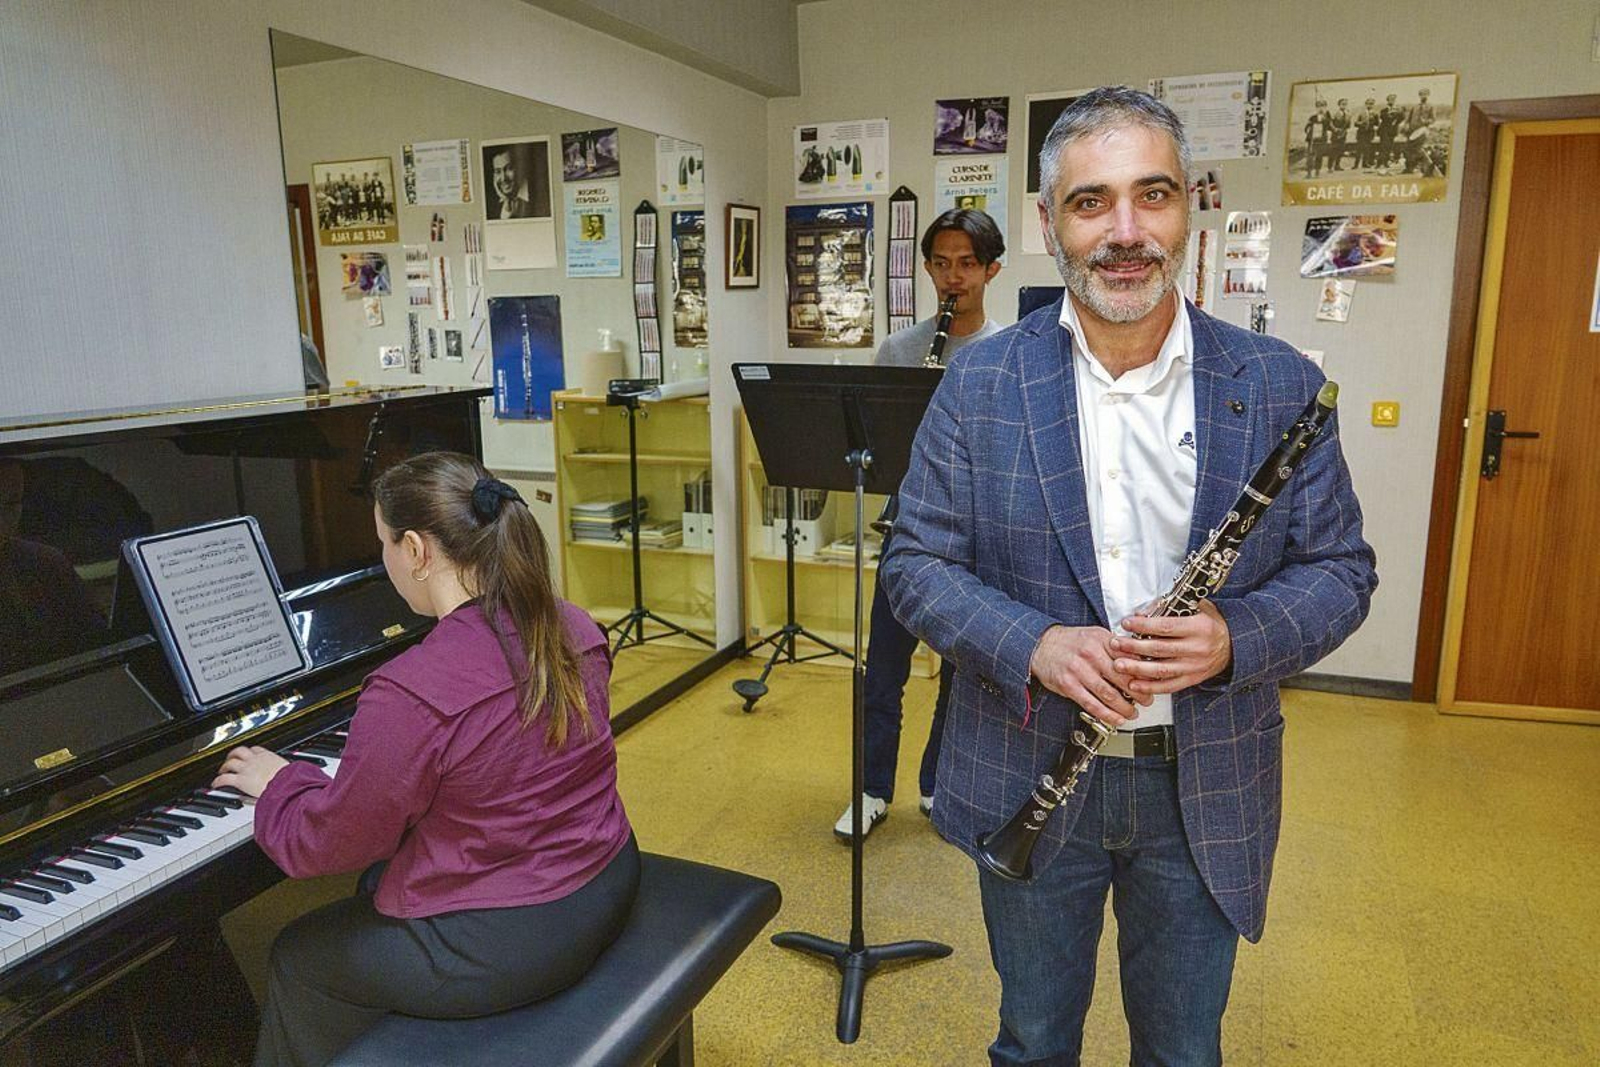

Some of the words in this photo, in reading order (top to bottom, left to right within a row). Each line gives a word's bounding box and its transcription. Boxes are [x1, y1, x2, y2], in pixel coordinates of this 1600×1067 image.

[1307, 183, 1344, 200] CAFÉ
[1352, 185, 1372, 198] DA
[1381, 183, 1419, 197] FALA
